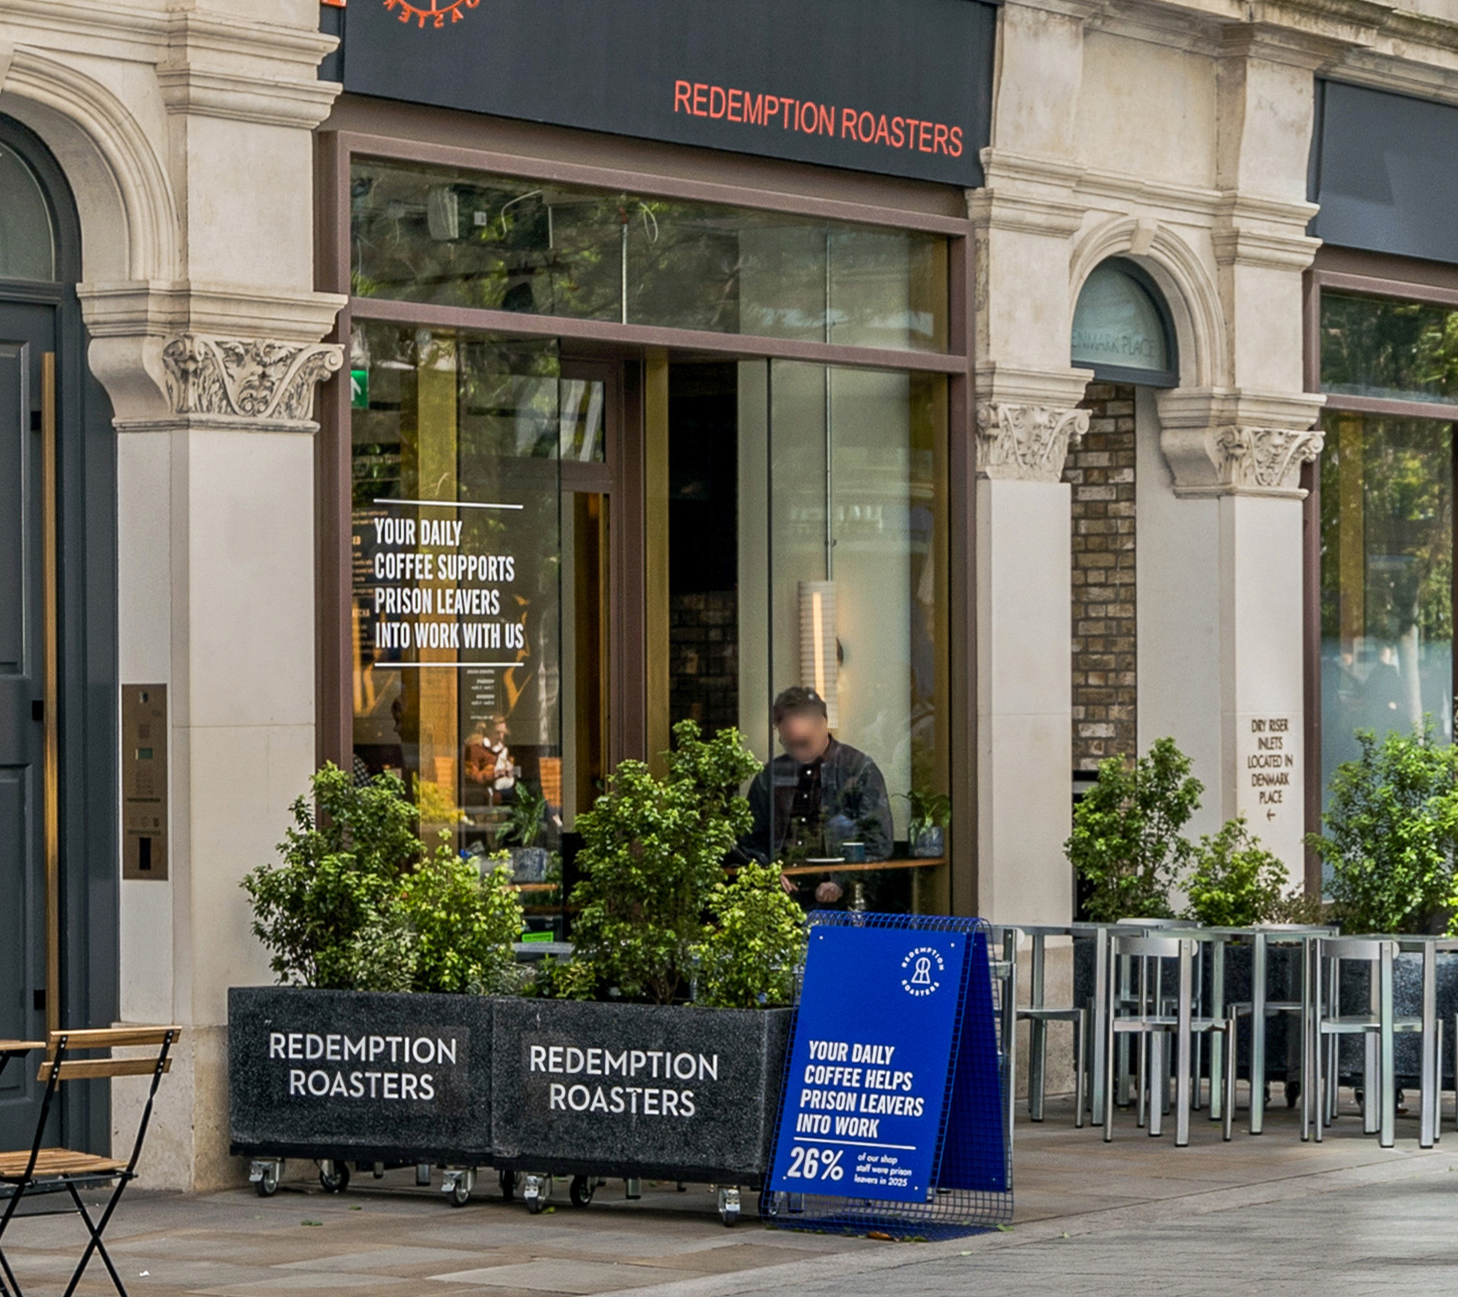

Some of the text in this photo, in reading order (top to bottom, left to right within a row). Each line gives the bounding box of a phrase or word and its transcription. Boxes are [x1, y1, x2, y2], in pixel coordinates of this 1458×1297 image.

[674, 80, 963, 158] REDEMPTION ROASTERS
[1071, 329, 1120, 353] ENMARK
[374, 518, 463, 547] YOUR DAILY
[374, 552, 433, 580] COFFEE
[437, 554, 515, 582] SUPPORTS
[374, 587, 500, 615] PRISON LEAVERS
[375, 622, 410, 649] INTO
[413, 622, 460, 649] WORK
[463, 622, 501, 649] WITH
[504, 622, 525, 650] US
[1251, 718, 1289, 733] DRY RISER
[1258, 736, 1283, 750] INLETS
[1247, 754, 1294, 769] LOCATED IN
[1251, 772, 1290, 787] DENMARK
[1259, 790, 1283, 805] PLACE
[901, 946, 945, 971] REDEMPTION
[901, 979, 940, 997] ROASTERS
[268, 1032, 457, 1066] REDEMPTION
[809, 1040, 895, 1065] YOUR DAILY
[529, 1045, 719, 1082] REDEMPTION
[289, 1069, 435, 1101] ROASTERS
[804, 1065, 913, 1091] COFFEE HELPS
[548, 1082, 696, 1117] ROASTERS
[800, 1089, 924, 1117] PRISON LEAVERS
[796, 1113, 880, 1138] INTO WORK
[787, 1146, 844, 1181] 26%
[856, 1164, 871, 1172] staff
[890, 1167, 912, 1177] prison
[857, 1152, 867, 1161] of
[880, 1154, 898, 1166] shop
[854, 1173, 908, 1187] leavers in 2025
